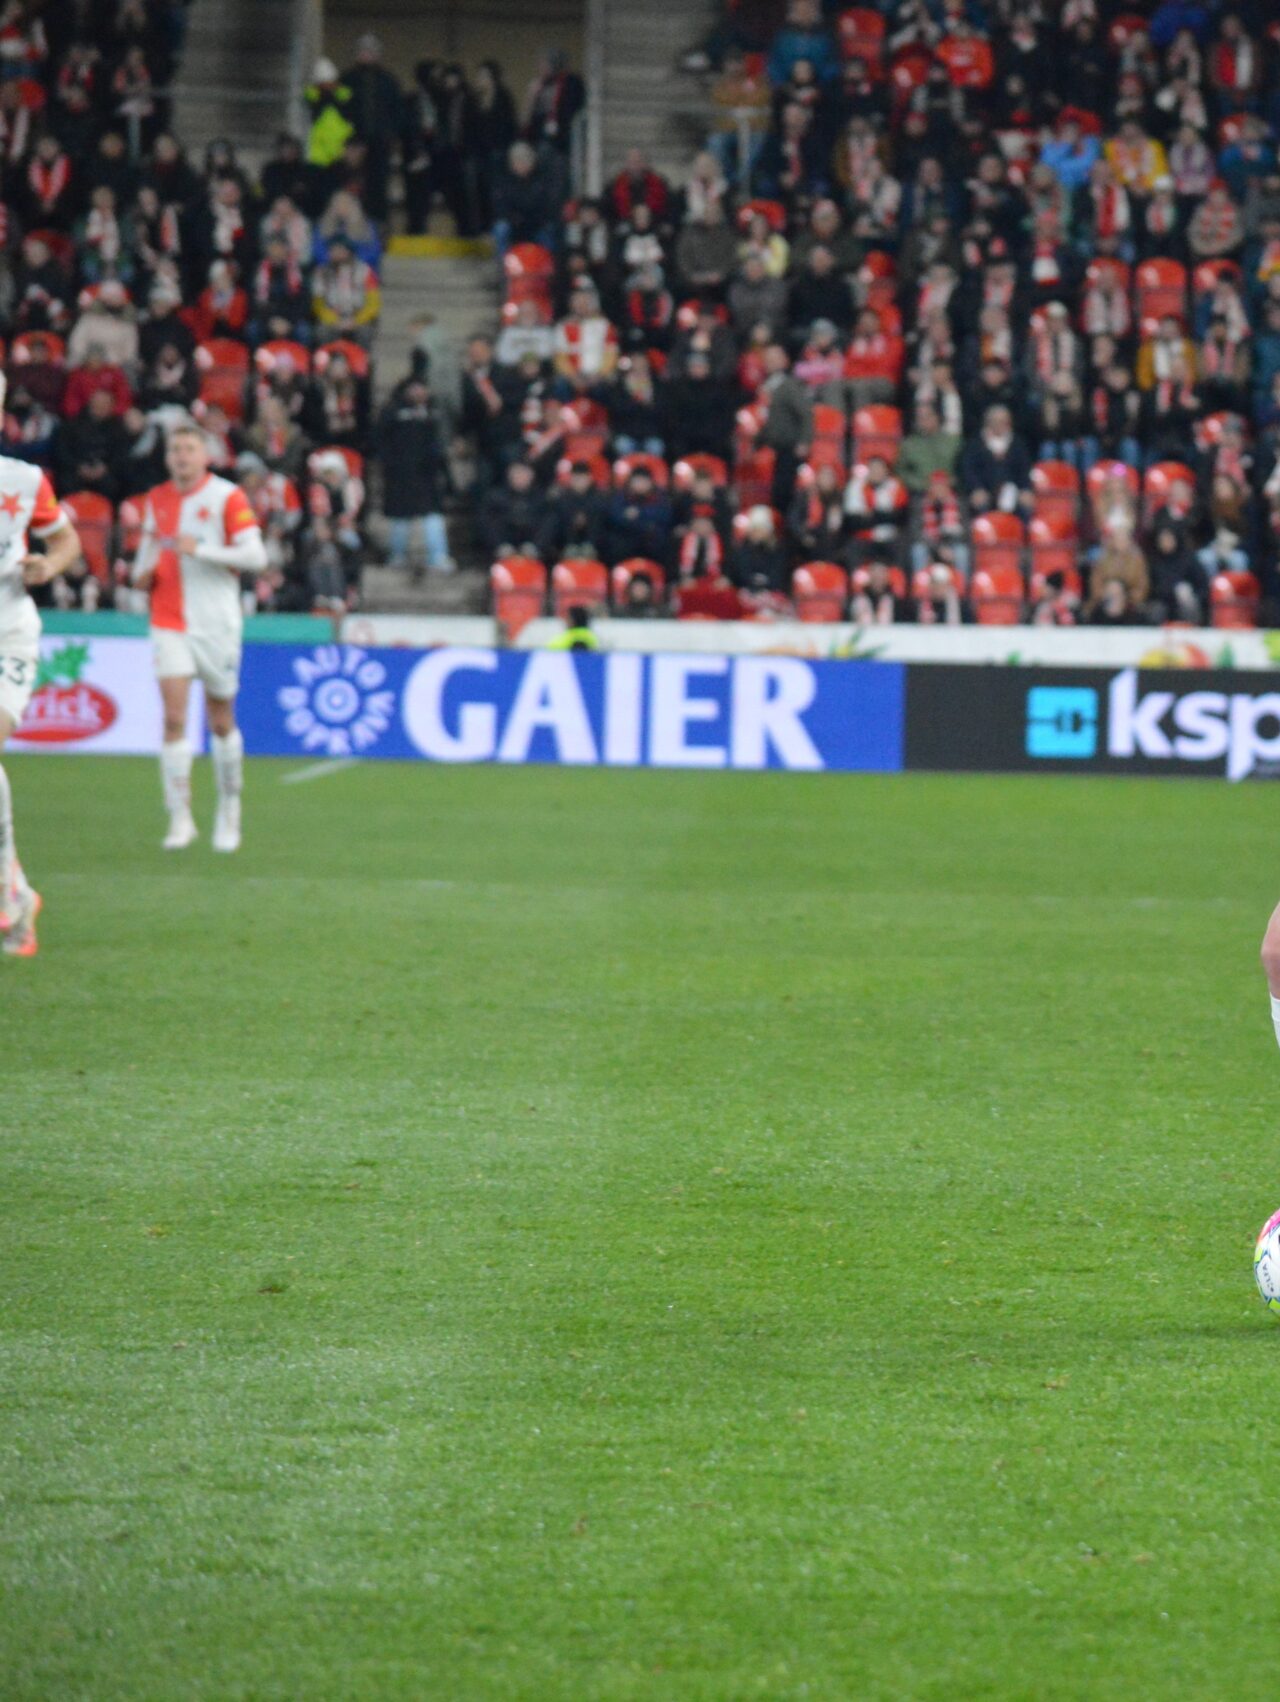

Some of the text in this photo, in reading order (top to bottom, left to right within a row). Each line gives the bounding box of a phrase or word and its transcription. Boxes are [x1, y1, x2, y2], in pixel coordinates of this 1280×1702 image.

[292, 645, 387, 690] AUTO
[277, 686, 395, 757] DOPRAVA
[402, 647, 827, 770] GAIER
